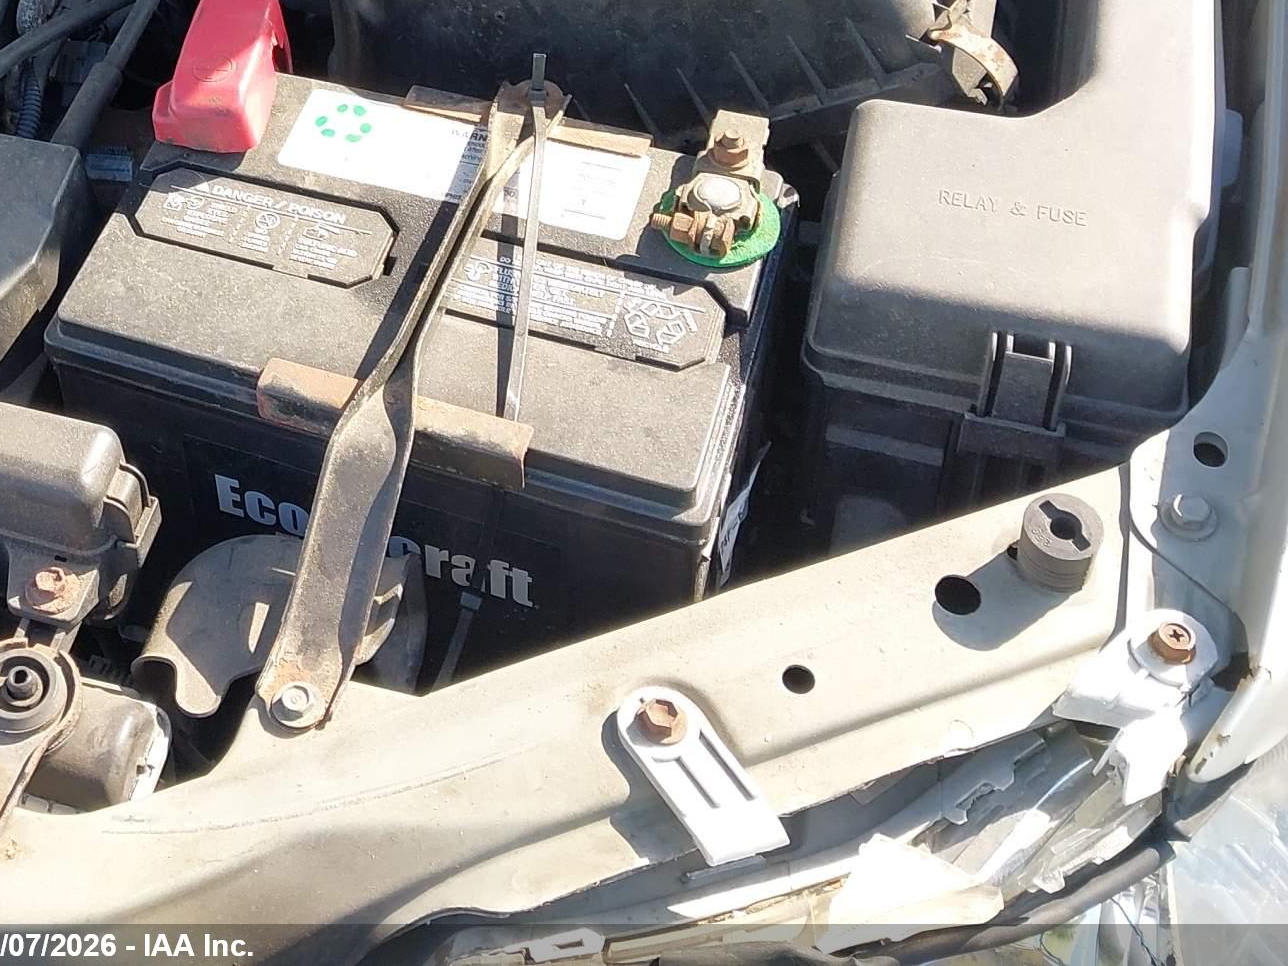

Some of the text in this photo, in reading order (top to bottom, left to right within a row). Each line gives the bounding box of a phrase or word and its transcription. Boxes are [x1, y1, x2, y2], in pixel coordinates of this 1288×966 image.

[213, 185, 274, 208] DANGER
[287, 201, 348, 226] POISON
[938, 189, 1088, 227] RELAY & FUSE
